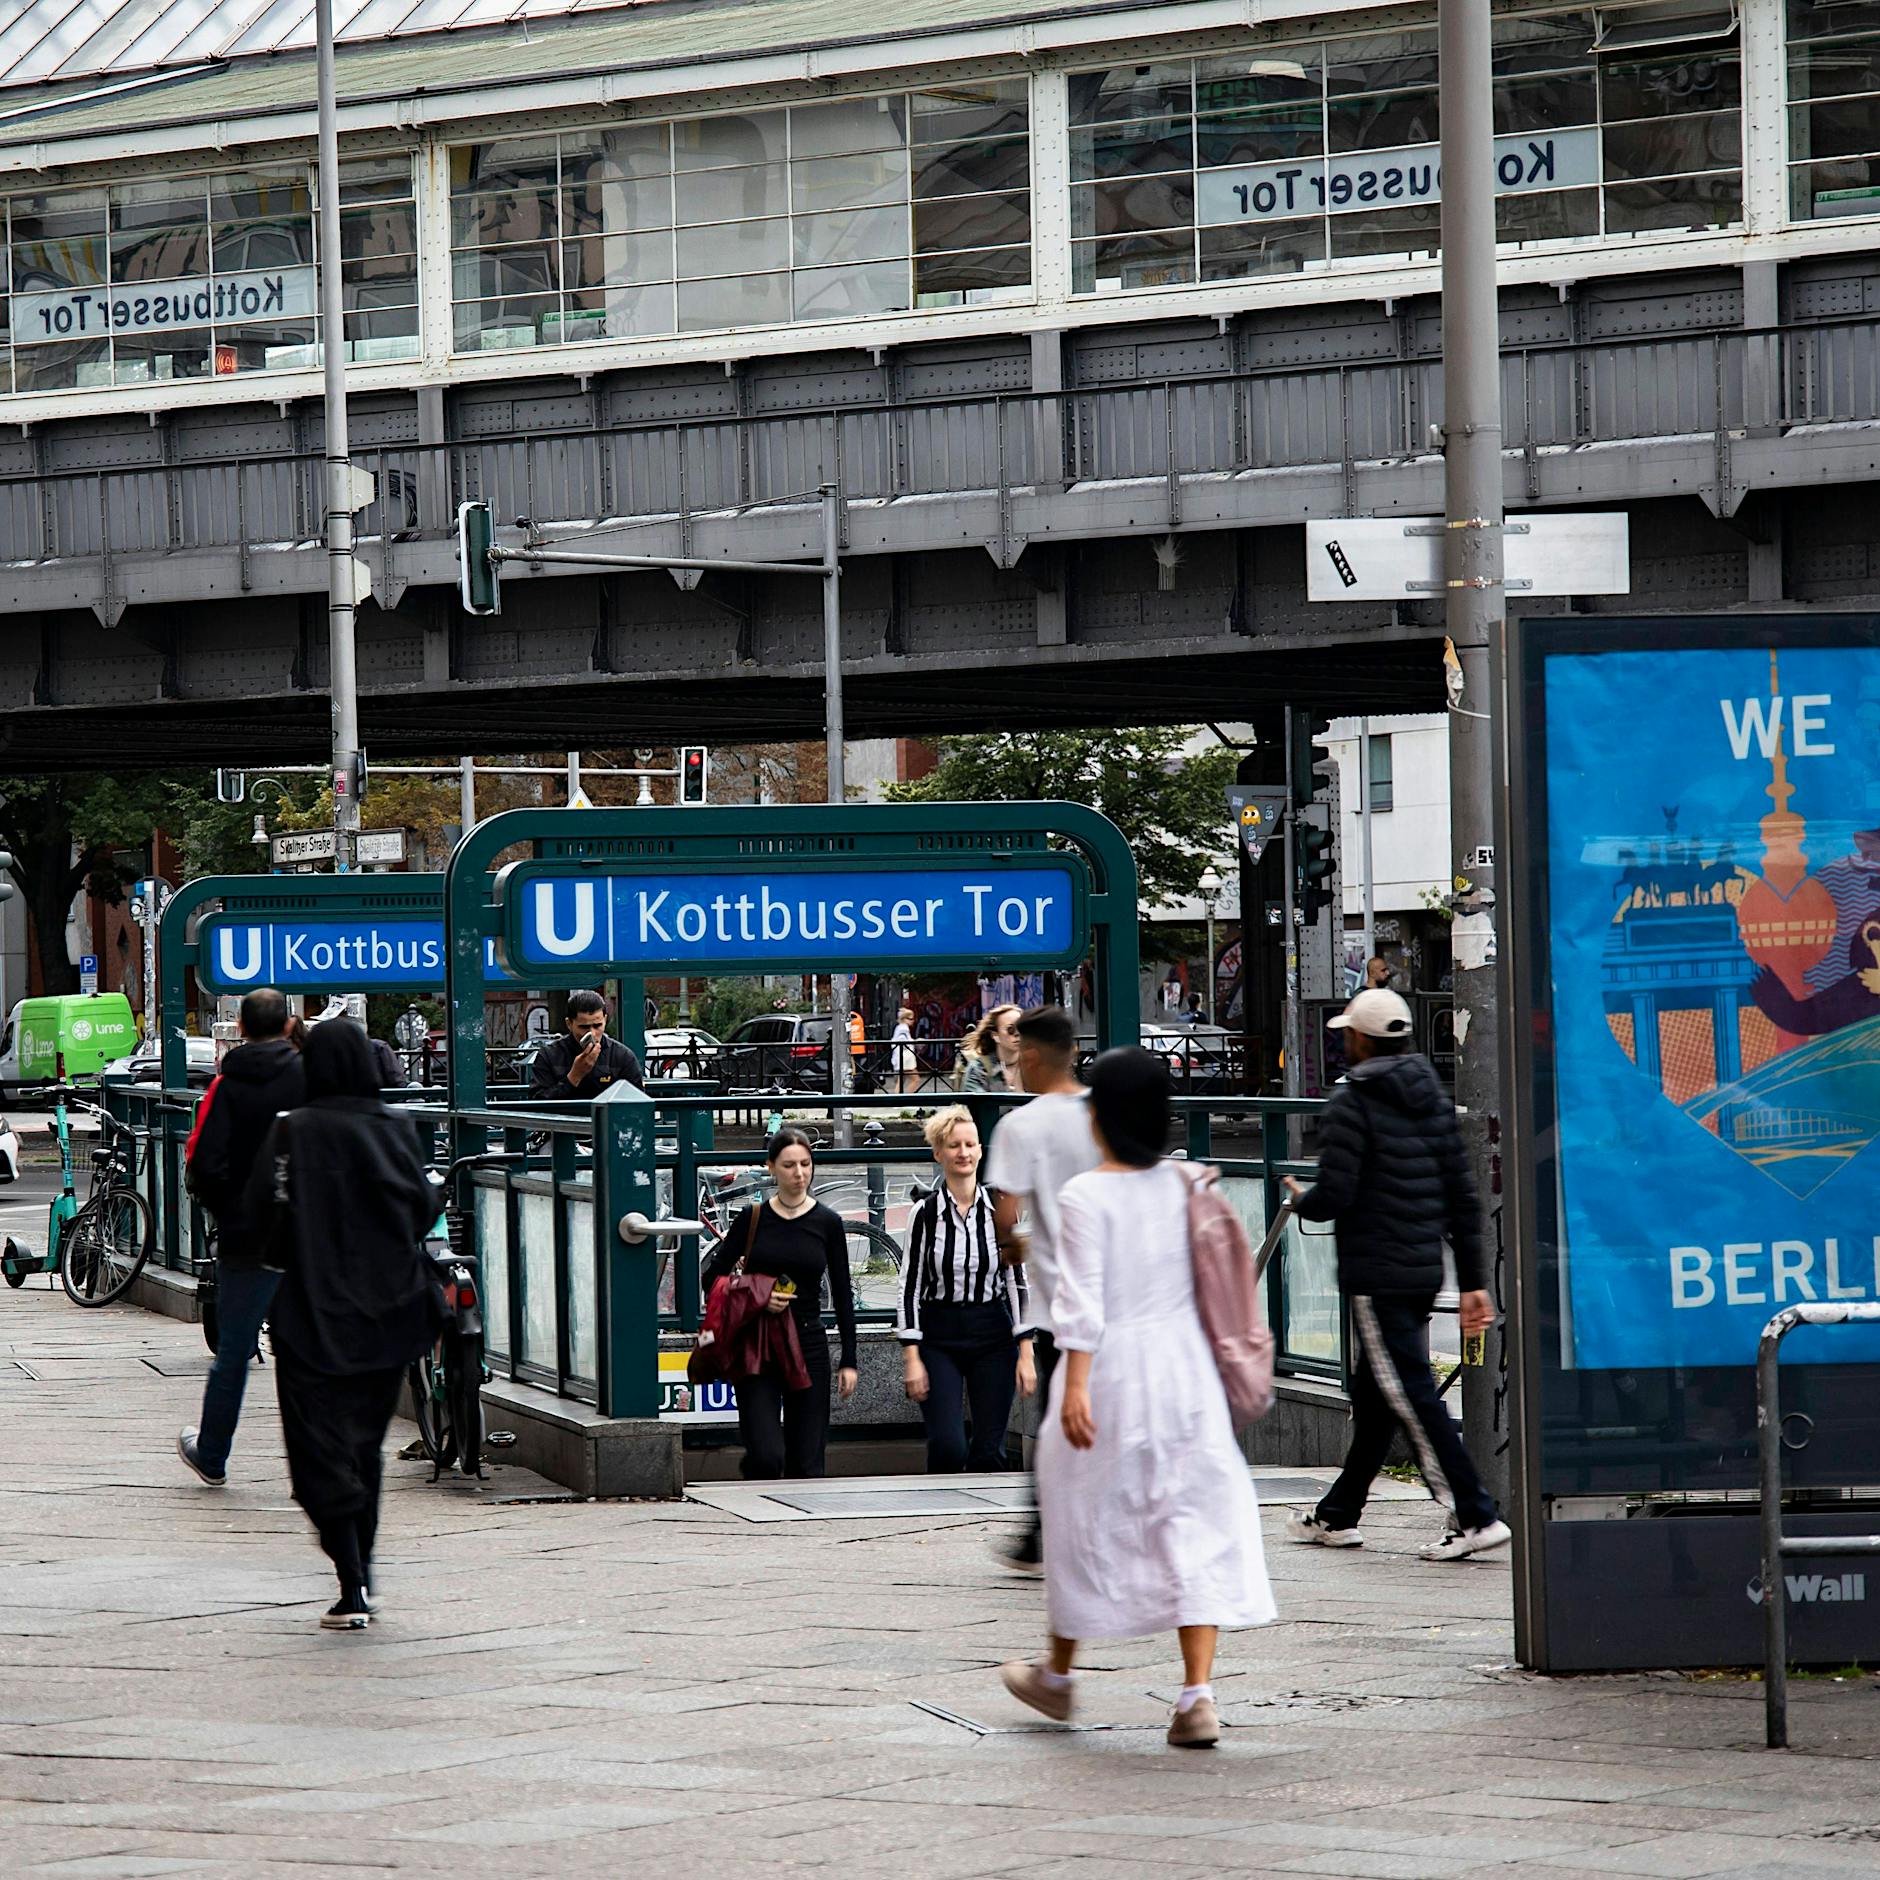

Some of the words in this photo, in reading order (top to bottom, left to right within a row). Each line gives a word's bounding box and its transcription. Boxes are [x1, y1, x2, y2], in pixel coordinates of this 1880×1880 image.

[1719, 693, 1835, 760] WE
[535, 882, 595, 956] U
[638, 886, 944, 943] Kottbusser
[962, 885, 1054, 937] Tor
[83, 957, 94, 972] P
[219, 927, 262, 981] U
[284, 930, 494, 971] Kottbusr
[95, 1022, 125, 1035] Lime
[35, 1039, 55, 1058] Lime
[1783, 1573, 1865, 1603] Wall
